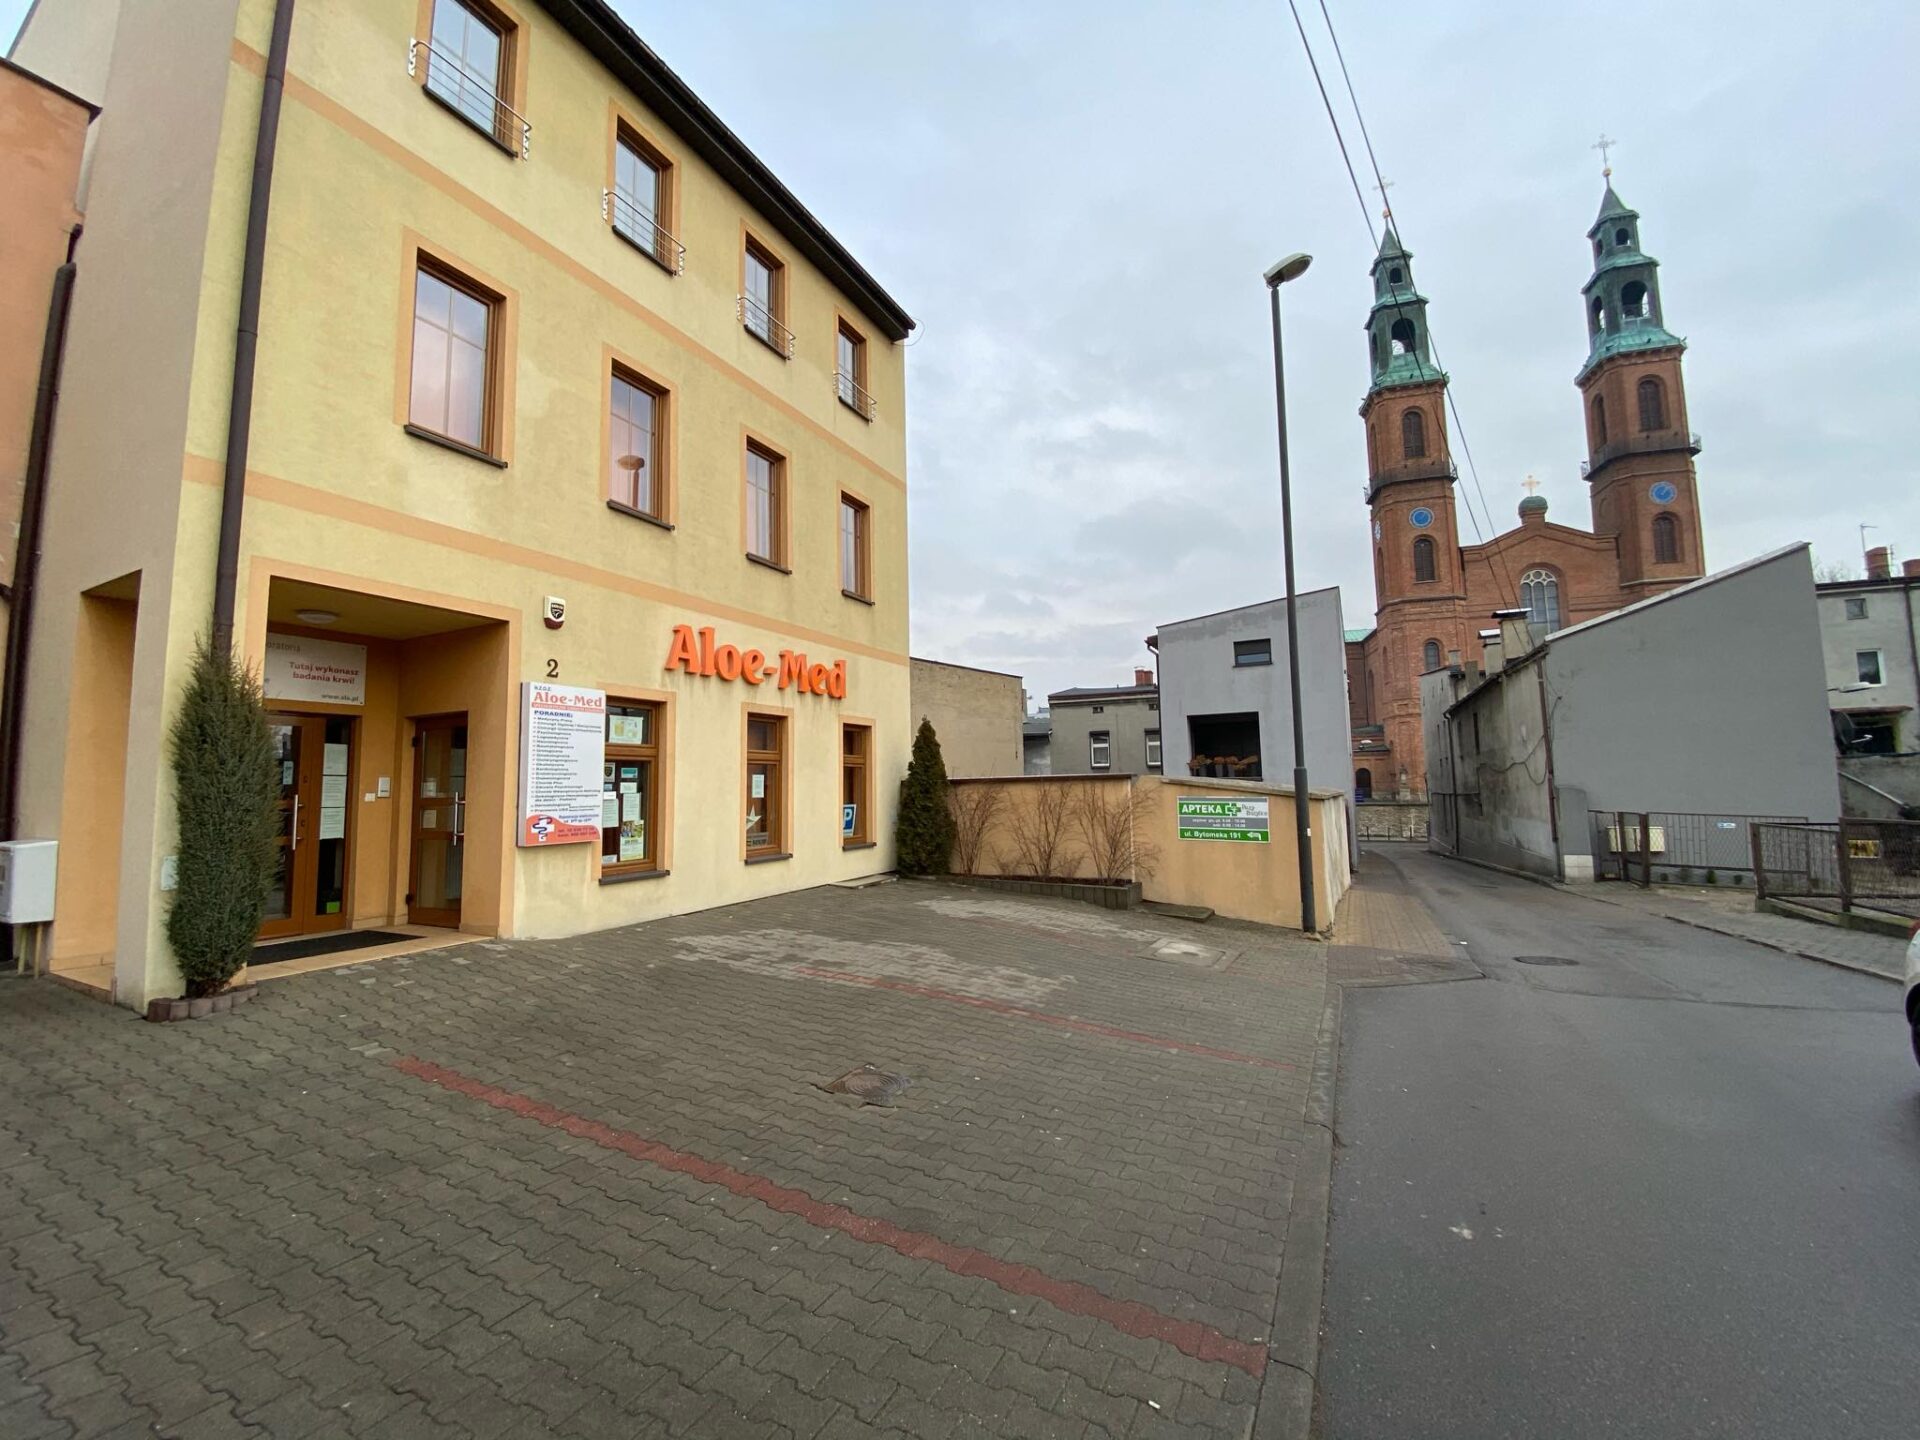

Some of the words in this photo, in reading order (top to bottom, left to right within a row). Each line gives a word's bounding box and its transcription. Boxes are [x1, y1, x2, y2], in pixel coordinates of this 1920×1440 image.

[290, 662, 314, 672] Tutaj
[315, 665, 359, 676] wykonasz
[546, 658, 558, 678] 2
[665, 624, 846, 700] Aloe-Med
[293, 672, 331, 682] badania
[332, 676, 355, 684] krwi!
[534, 691, 602, 707] Aloe-Med
[1181, 804, 1222, 814] APTEKA
